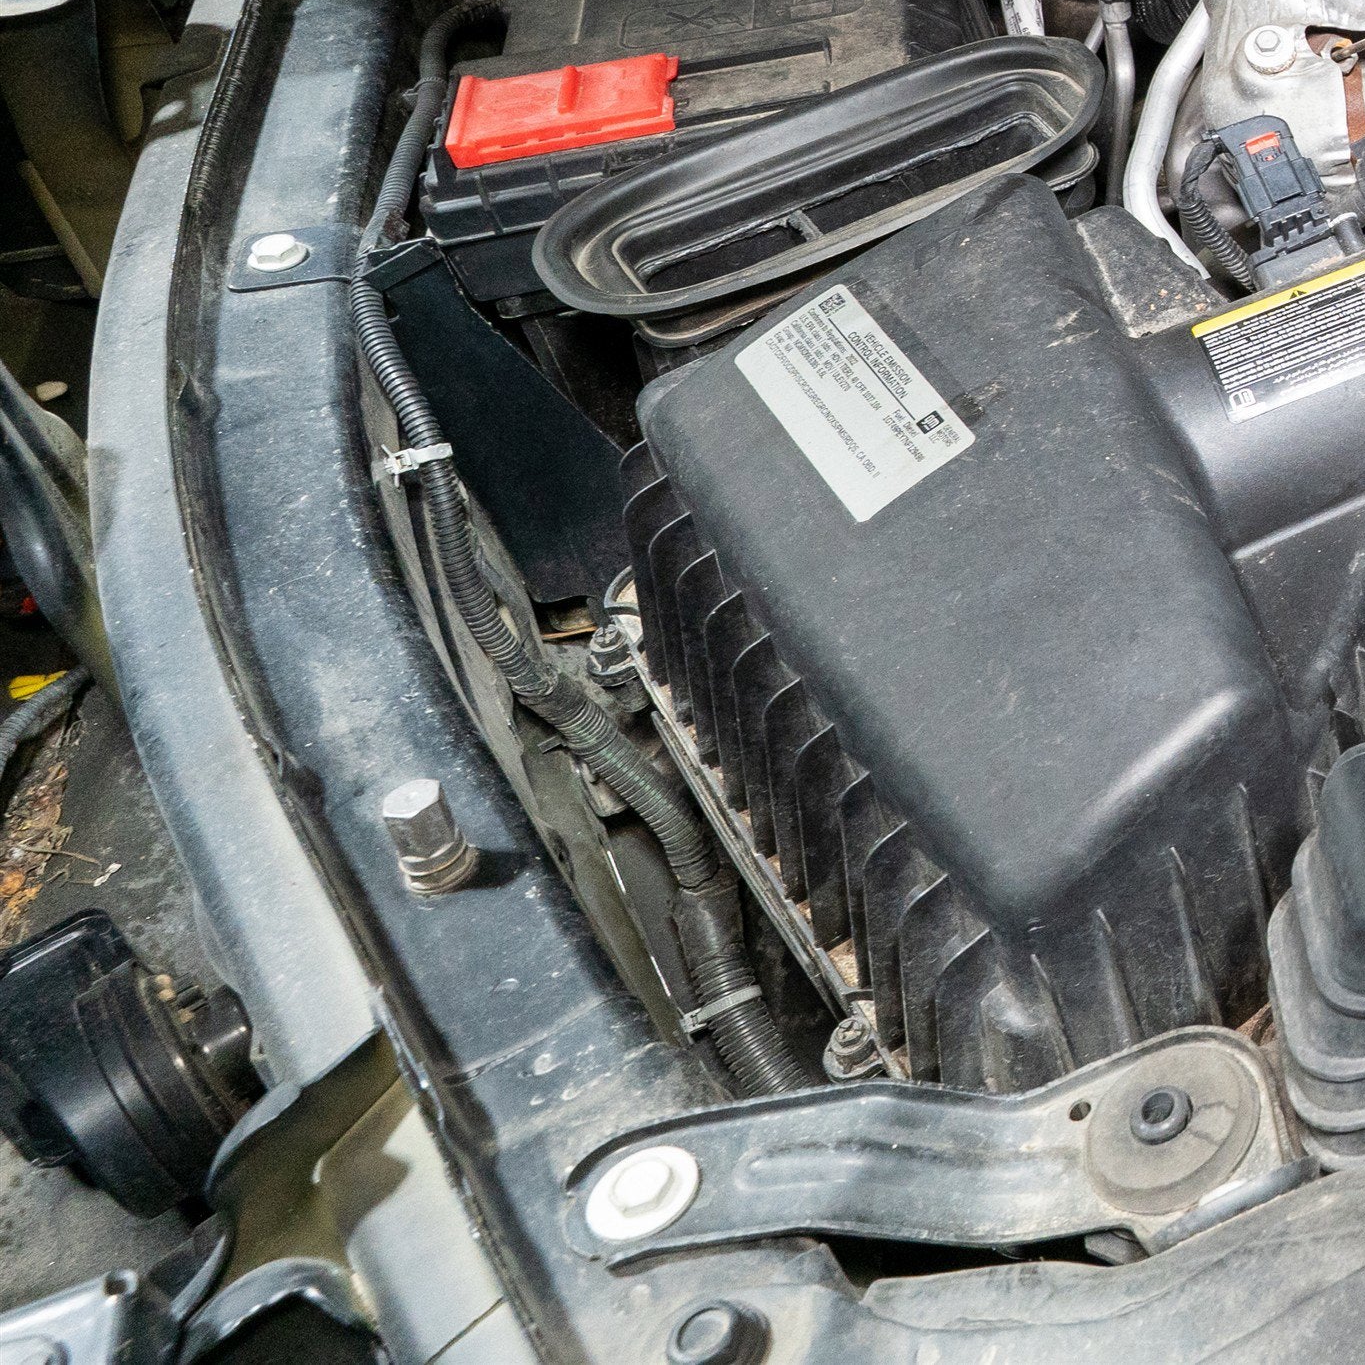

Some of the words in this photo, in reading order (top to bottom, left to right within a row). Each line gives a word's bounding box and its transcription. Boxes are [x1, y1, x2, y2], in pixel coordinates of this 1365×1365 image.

[806, 307, 826, 327] Conforms
[804, 320, 816, 331] EPA
[810, 328, 824, 341] class
[853, 380, 867, 393] CFR
[846, 330, 875, 361] CONTROL
[869, 357, 909, 399] INFORMATION
[862, 331, 888, 358] VEHICLE
[882, 355, 913, 386] EMISSION
[901, 420, 919, 438] Diesel
[927, 433, 939, 444] LLC
[935, 428, 954, 447] MOTORS
[942, 423, 962, 443] GENERAL
[854, 450, 866, 461] CA
